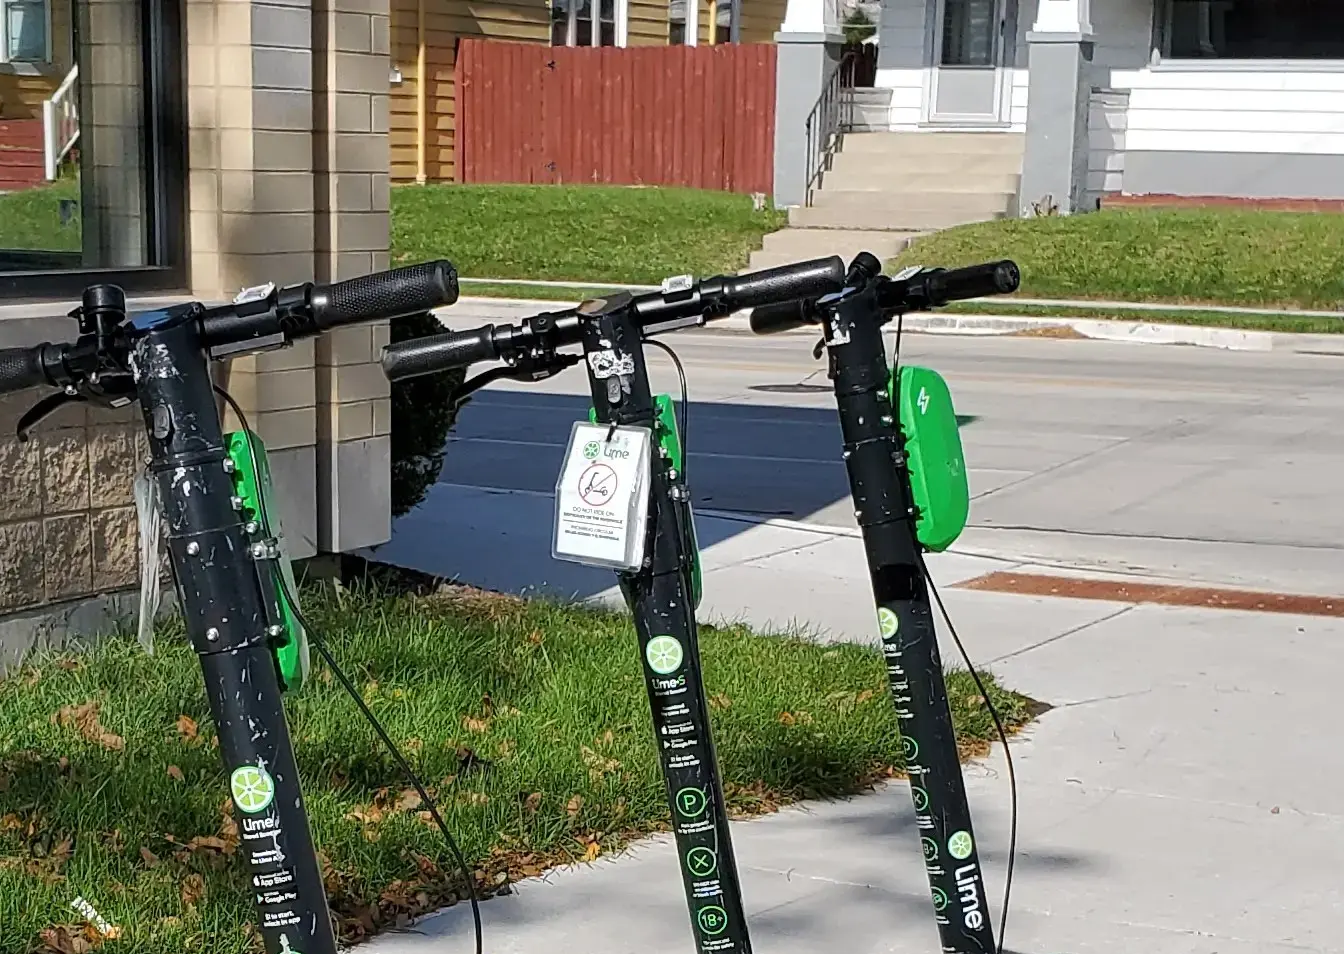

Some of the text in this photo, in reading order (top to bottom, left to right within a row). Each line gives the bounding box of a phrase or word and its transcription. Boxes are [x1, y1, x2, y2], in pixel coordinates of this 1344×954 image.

[683, 794, 697, 811] P
[242, 817, 274, 832] Lime
[274, 874, 293, 884] Store
[954, 863, 984, 930] Lime
